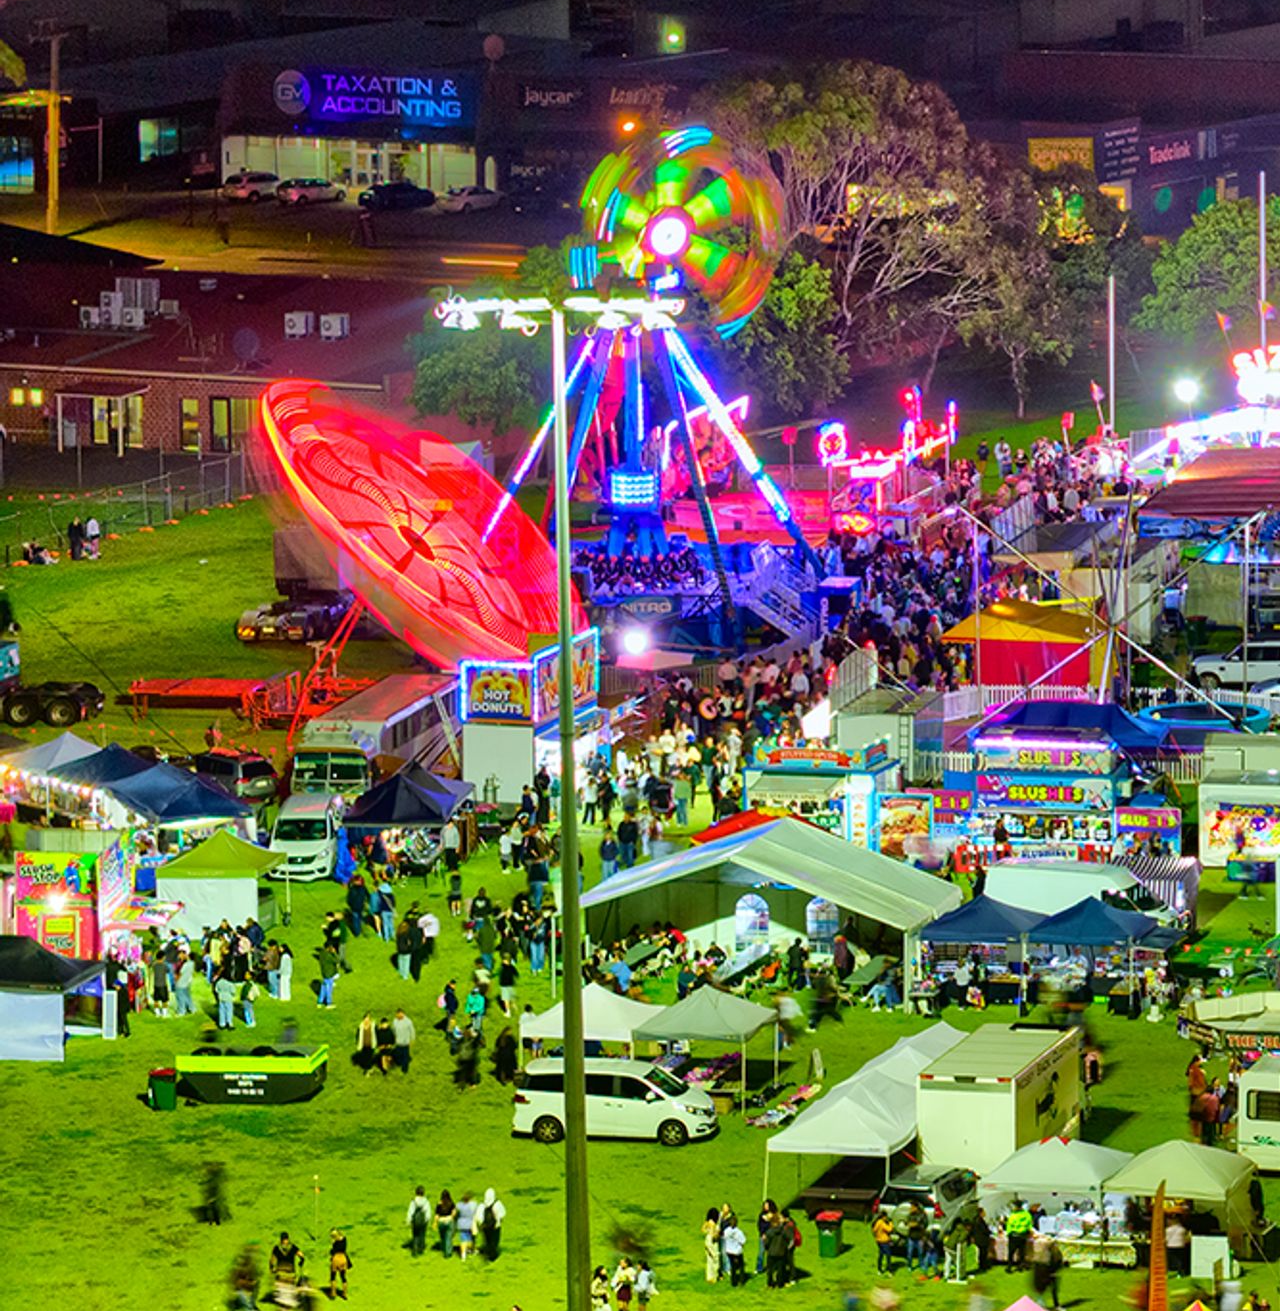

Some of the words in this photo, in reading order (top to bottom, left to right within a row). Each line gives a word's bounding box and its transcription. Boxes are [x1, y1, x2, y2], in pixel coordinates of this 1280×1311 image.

[322, 74, 433, 96] TAXATION
[441, 79, 459, 96] &
[524, 87, 575, 106] jaycar
[321, 98, 462, 120] ACCOUNTING
[1149, 141, 1192, 164] Tradelink
[620, 599, 673, 614] NITRO
[483, 689, 512, 702] HOT
[472, 700, 524, 715] DONUTS
[1019, 749, 1082, 769] SLUSHIES
[1009, 784, 1083, 802] SLUSHIES
[934, 796, 970, 810] SHIES
[19, 863, 55, 879] SLUSH
[32, 871, 60, 885] STOP
[1227, 1035, 1257, 1048] THE
